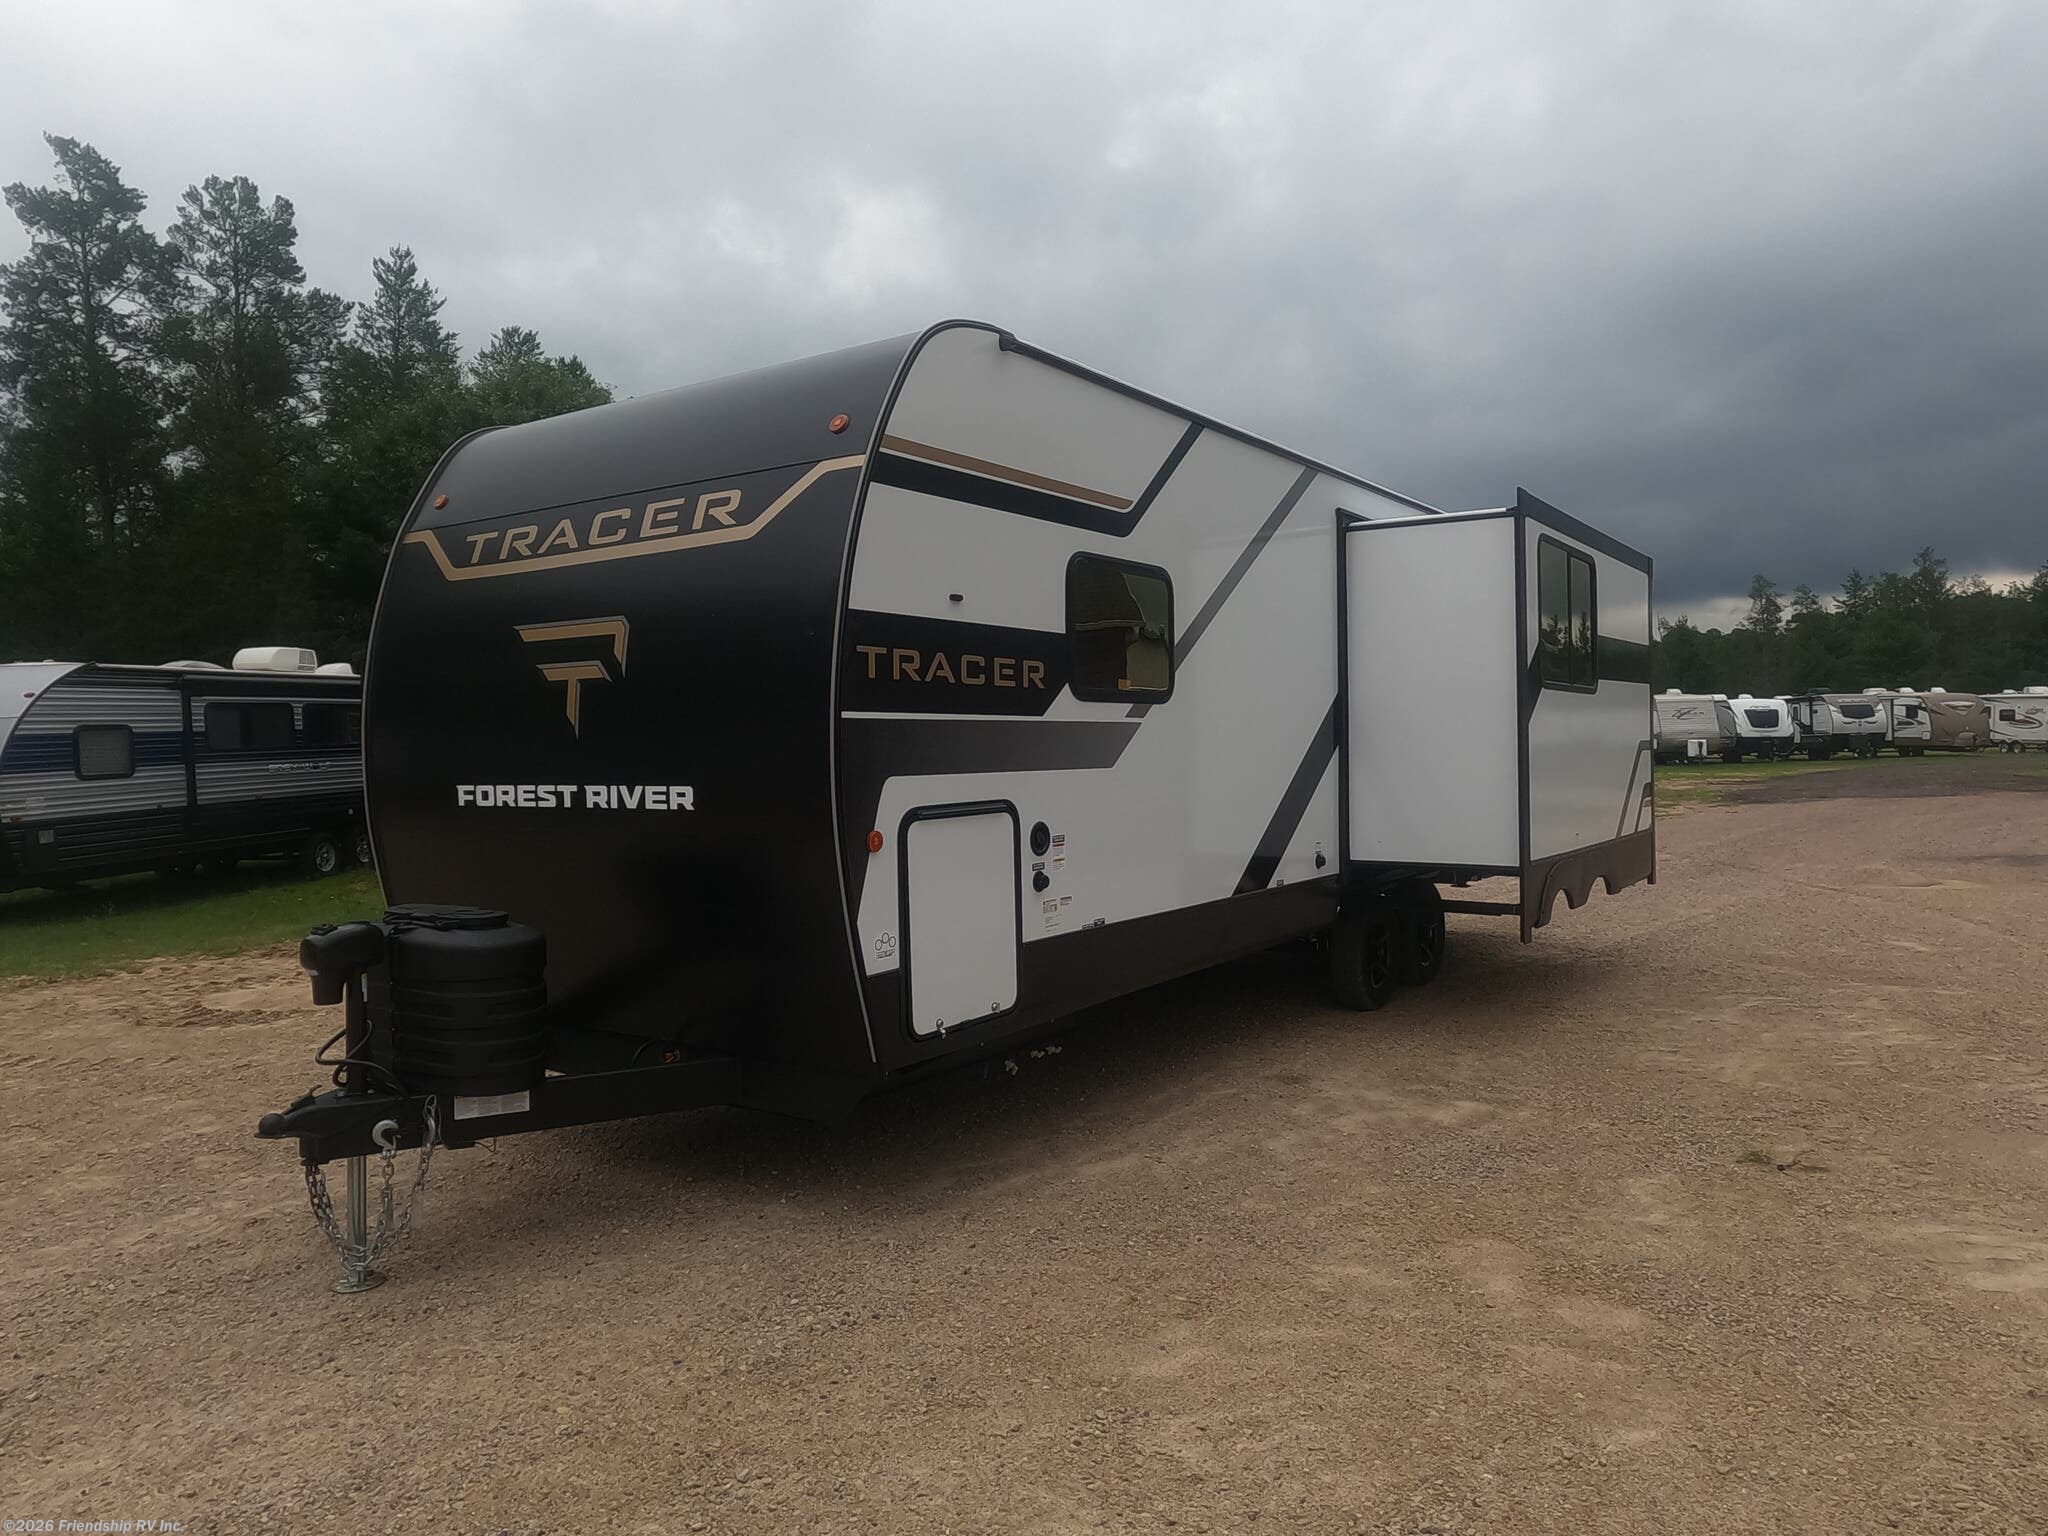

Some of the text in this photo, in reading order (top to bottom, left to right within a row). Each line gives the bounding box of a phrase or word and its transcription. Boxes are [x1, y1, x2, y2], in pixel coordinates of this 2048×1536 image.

[465, 489, 742, 564] TRACER
[856, 645, 1046, 688] TRACER
[456, 784, 695, 811] FOREST RIVER
